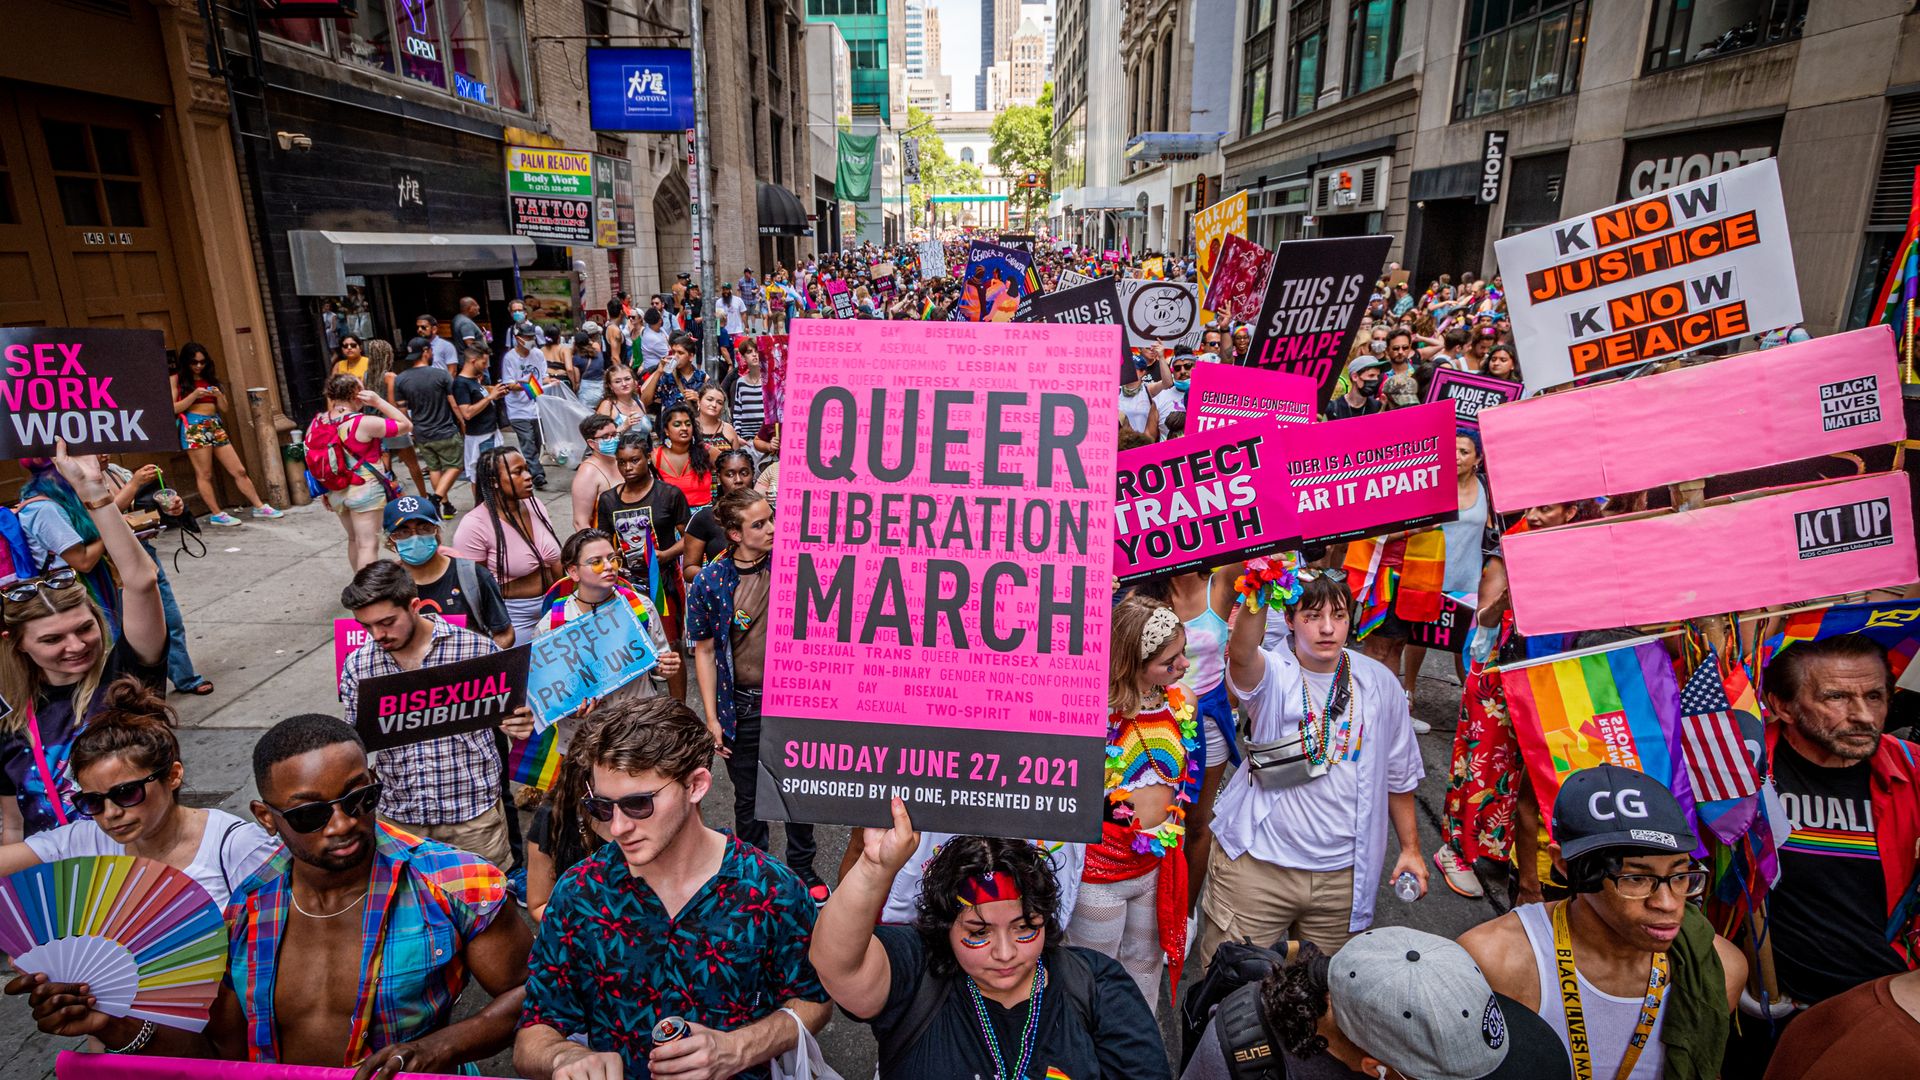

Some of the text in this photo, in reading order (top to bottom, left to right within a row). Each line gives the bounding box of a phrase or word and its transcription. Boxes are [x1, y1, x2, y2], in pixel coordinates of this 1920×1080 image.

[407, 37, 436, 60] OPEN
[521, 153, 587, 172] PALM READING
[523, 172, 579, 186] Body Work
[1481, 133, 1505, 201] CHOPT
[515, 198, 588, 219] TATTOO
[520, 215, 586, 227] PIERCING
[1197, 198, 1245, 231] TAKING
[1555, 182, 1718, 256] KNOW
[83, 232, 105, 244] 143
[120, 232, 132, 244] 41
[1532, 213, 1757, 300] JUSTICE
[1120, 281, 1138, 298] NO
[1279, 274, 1364, 309] THIS IS
[1570, 271, 1732, 338] KNOW
[1054, 304, 1092, 324] THIS
[1096, 299, 1112, 316] IS
[1268, 304, 1355, 337] STOLEN
[797, 341, 1113, 359] INTERSEX ASEXUAL TWO-SPIRIT NON-BINARY
[798, 325, 1114, 342] LESBIAN GAY BISEXUAL TRANS QUEER
[1258, 331, 1345, 365] LENAPE
[1572, 303, 1746, 374] PEACE
[4, 343, 87, 377] SEX
[795, 357, 1112, 375] GENDER NON-CONFORMING LESBIAN GAY BISEXUAL
[794, 373, 1112, 391] TRANS QUEER INTERSEX ASEXUAL TWO-SPIRIT
[1447, 384, 1501, 407] NADIE ES
[1821, 375, 1876, 399] BLACK
[1202, 390, 1310, 415] GENDER IS A CONSTRUCT
[1823, 393, 1877, 414] LIVES
[10, 409, 150, 446] WORK
[1824, 409, 1880, 431] MATTER
[805, 385, 1089, 490] QUEER
[1325, 455, 1339, 471] IS
[1343, 454, 1356, 468] A
[1356, 436, 1440, 465] CONSTRUCT
[1116, 435, 1264, 502] ROTECT
[1336, 482, 1358, 506] IT
[1364, 465, 1441, 501] APART
[1114, 475, 1257, 536] TRANS
[800, 490, 1089, 555] LIBERATION
[1115, 506, 1264, 566] YOUTH
[1800, 501, 1888, 549] ACT UP
[1801, 550, 1816, 559] AIDS
[1816, 546, 1843, 557] Coalition
[1850, 541, 1874, 551] Unleash
[1874, 538, 1893, 547] Power
[792, 552, 1087, 656] MARCH
[1017, 601, 1037, 614] GAY
[529, 608, 621, 673] RESPECT
[564, 640, 599, 673] MY
[774, 641, 1102, 672] GAY BISEXUAL TRANS QUEER INTERSEX ASEXUAL
[773, 659, 1101, 690] TWO-SPIRIT NON-BINARY GENDER NON-CONFORMING
[379, 671, 512, 717] BISEXUAL
[772, 676, 1100, 708] LESBIAN GAY BISEXUAL TRANS QUEER
[377, 692, 511, 735] VISIBILITY
[770, 694, 1100, 726] INTERSEX ASEXUAL TWO-SPIRIT NON-BINARY
[784, 740, 1079, 788] SUNDAY JUNE 27, 2021
[782, 777, 1077, 814] SPONSORED BY NO ONE, PRESENTED BY US
[1588, 788, 1649, 821] CG
[1556, 948, 1581, 1003] BLACK
[1565, 1005, 1588, 1054] LIVES
[1234, 1044, 1272, 1063] ELITE
